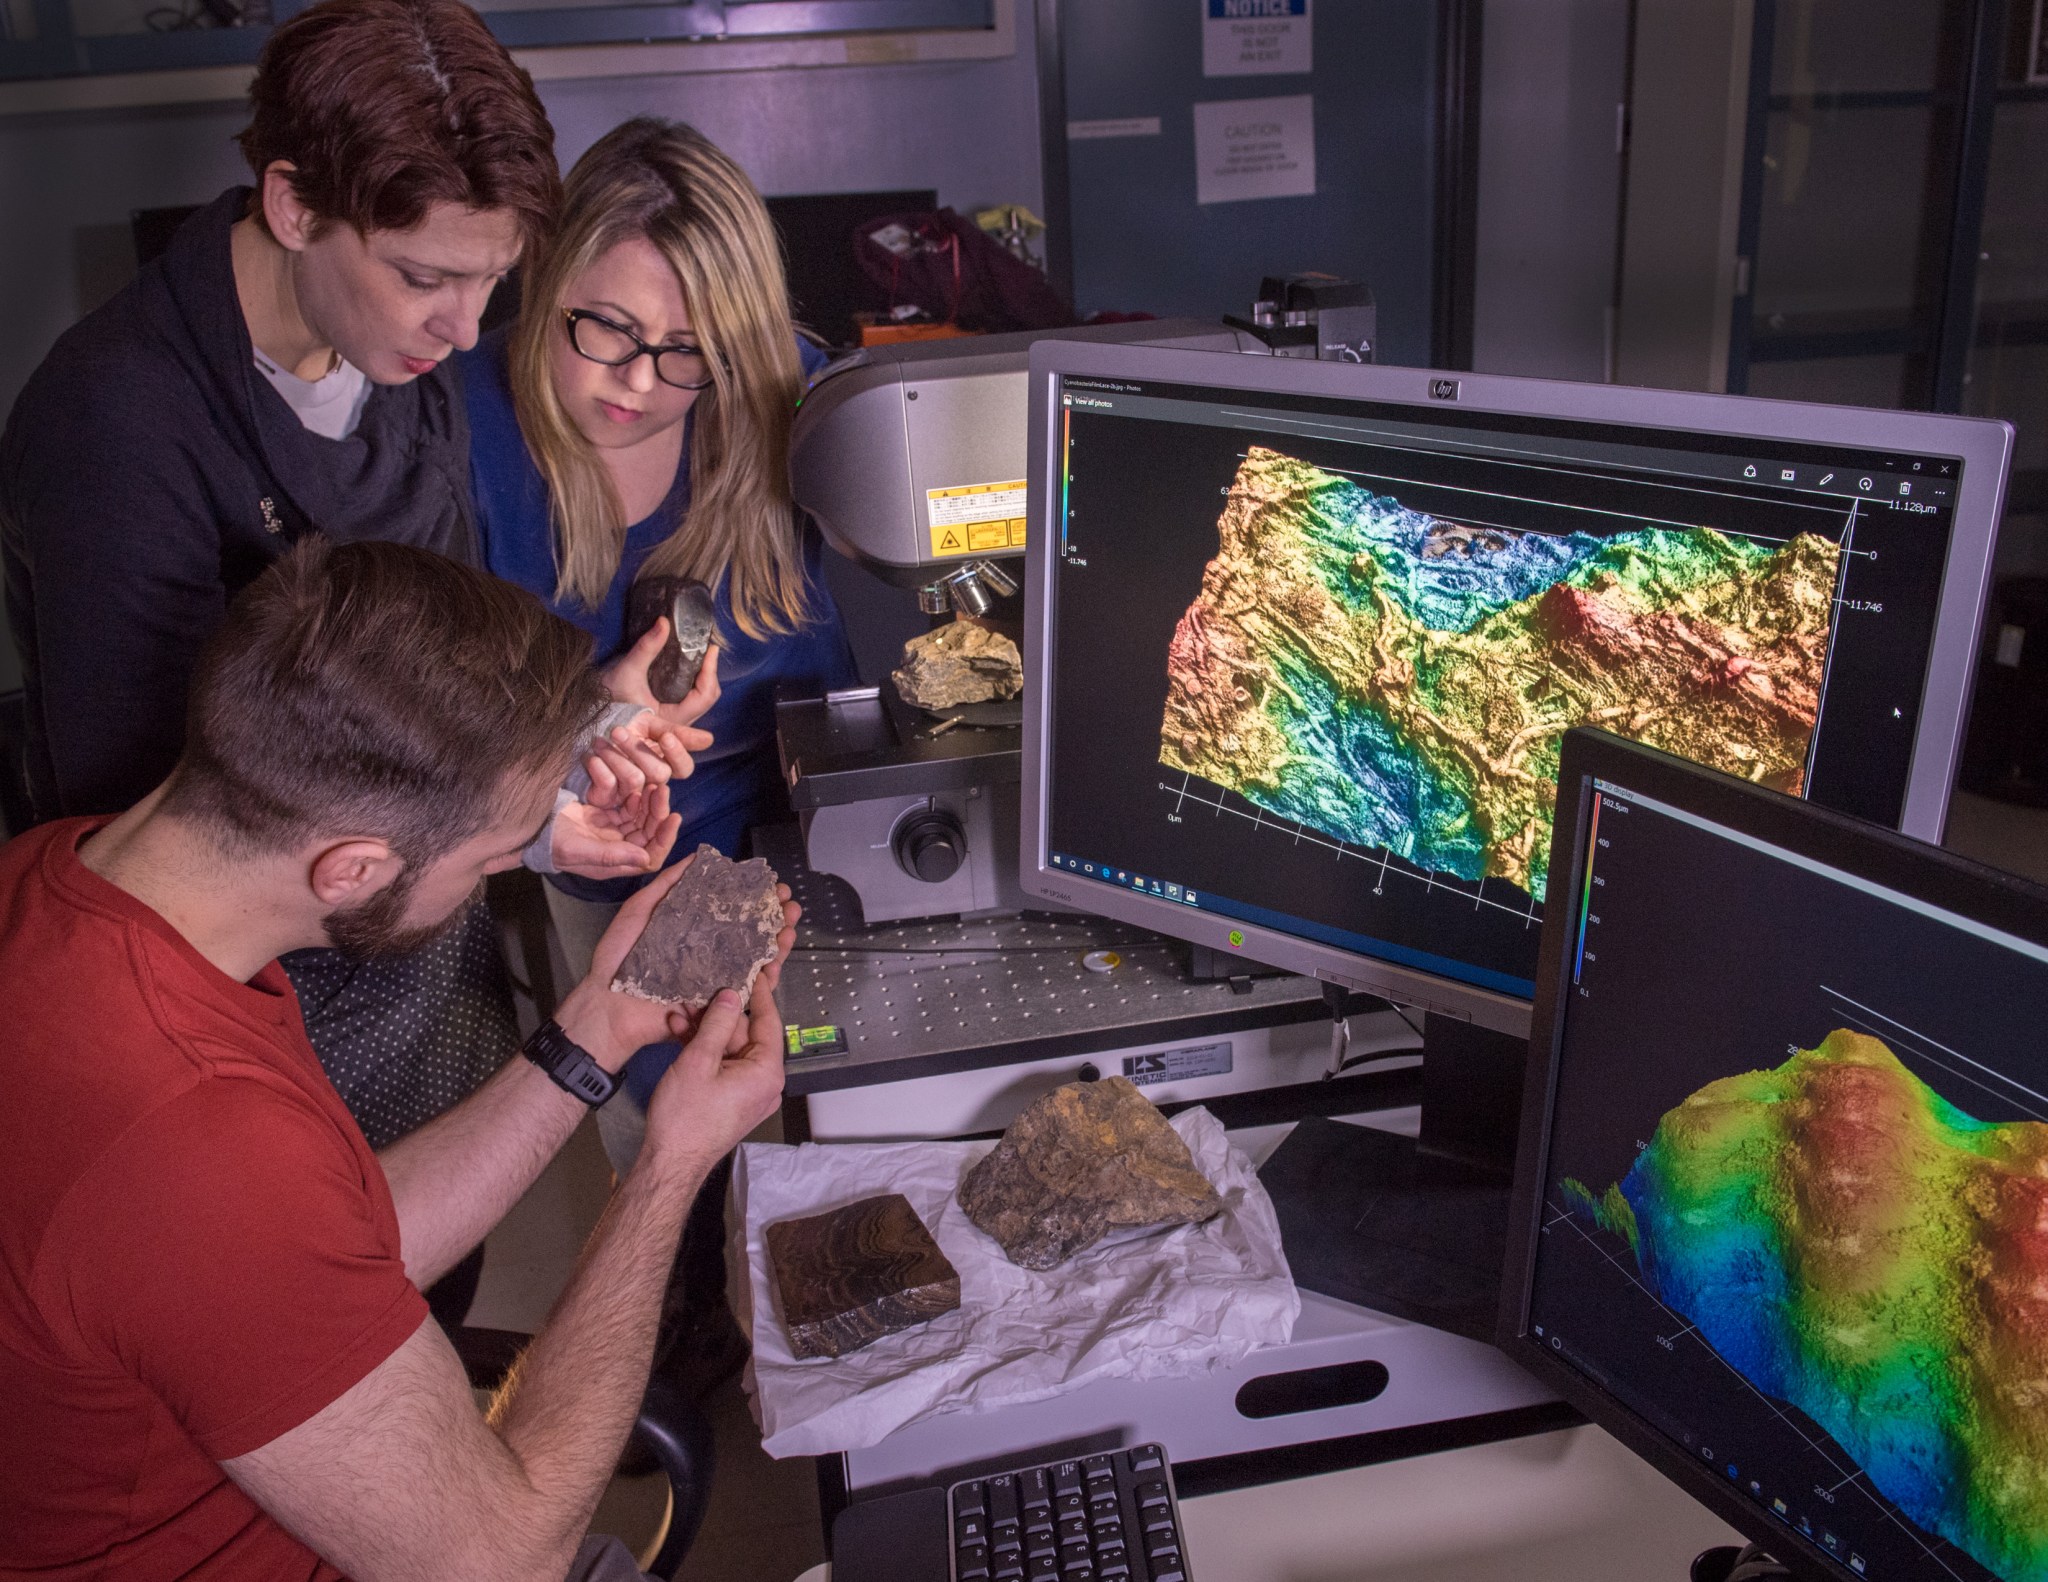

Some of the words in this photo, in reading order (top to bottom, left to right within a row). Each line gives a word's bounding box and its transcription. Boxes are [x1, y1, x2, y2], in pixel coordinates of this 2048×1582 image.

[1224, 0, 1290, 16] NOTICE
[1126, 384, 1142, 392] Photos
[1074, 397, 1088, 405] View
[1095, 399, 1113, 409] photos
[1889, 499, 1937, 515] 11.128µm
[1869, 550, 1878, 560] 0
[1158, 782, 1165, 790] 0
[1604, 782, 1613, 791] 3D
[1613, 786, 1635, 800] display
[1602, 797, 1629, 814] 502.5µm
[1598, 838, 1610, 848] 400
[1593, 875, 1605, 886] 300
[1588, 913, 1600, 924] 200
[1584, 951, 1596, 962] 100
[1579, 987, 1590, 998] 0.1
[1656, 1334, 1674, 1351] 1000
[1813, 1484, 1835, 1504] 2000
[1069, 1497, 1079, 1505] Q
[1038, 1510, 1047, 1518] A
[1073, 1521, 1083, 1531] W
[1006, 1528, 1015, 1536] Z
[1008, 1553, 1017, 1562] X
[1043, 1559, 1053, 1567] D
[1080, 1570, 1089, 1578] R
